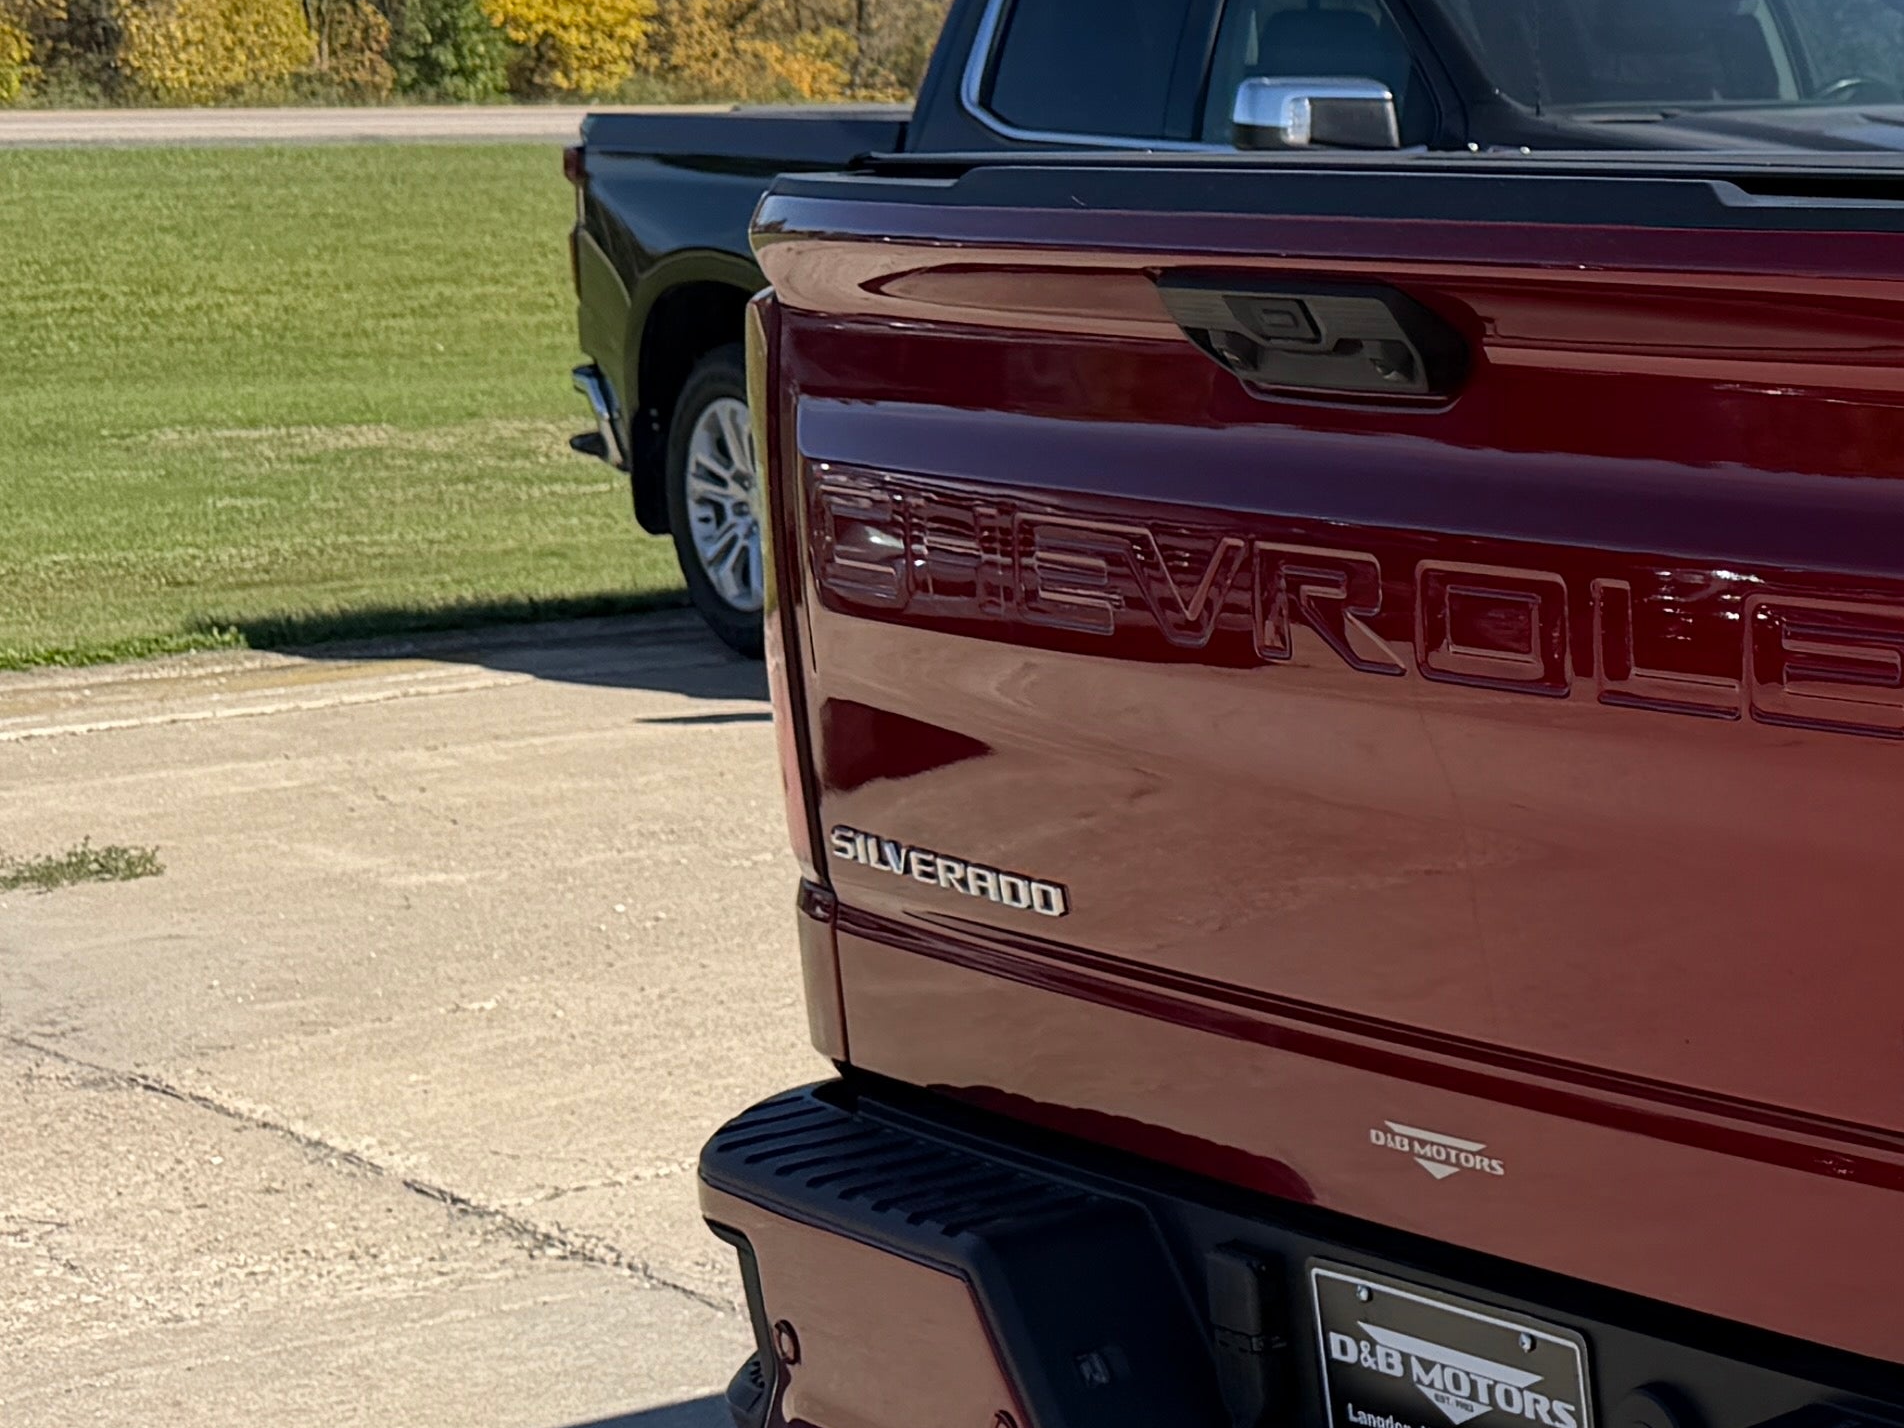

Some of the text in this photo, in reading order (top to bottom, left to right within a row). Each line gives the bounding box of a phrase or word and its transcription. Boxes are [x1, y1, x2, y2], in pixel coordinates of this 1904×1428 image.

[830, 824, 1069, 917] SILVERADO
[1370, 1128, 1505, 1176] D&B MOTORS
[1329, 1331, 1404, 1378] D&B
